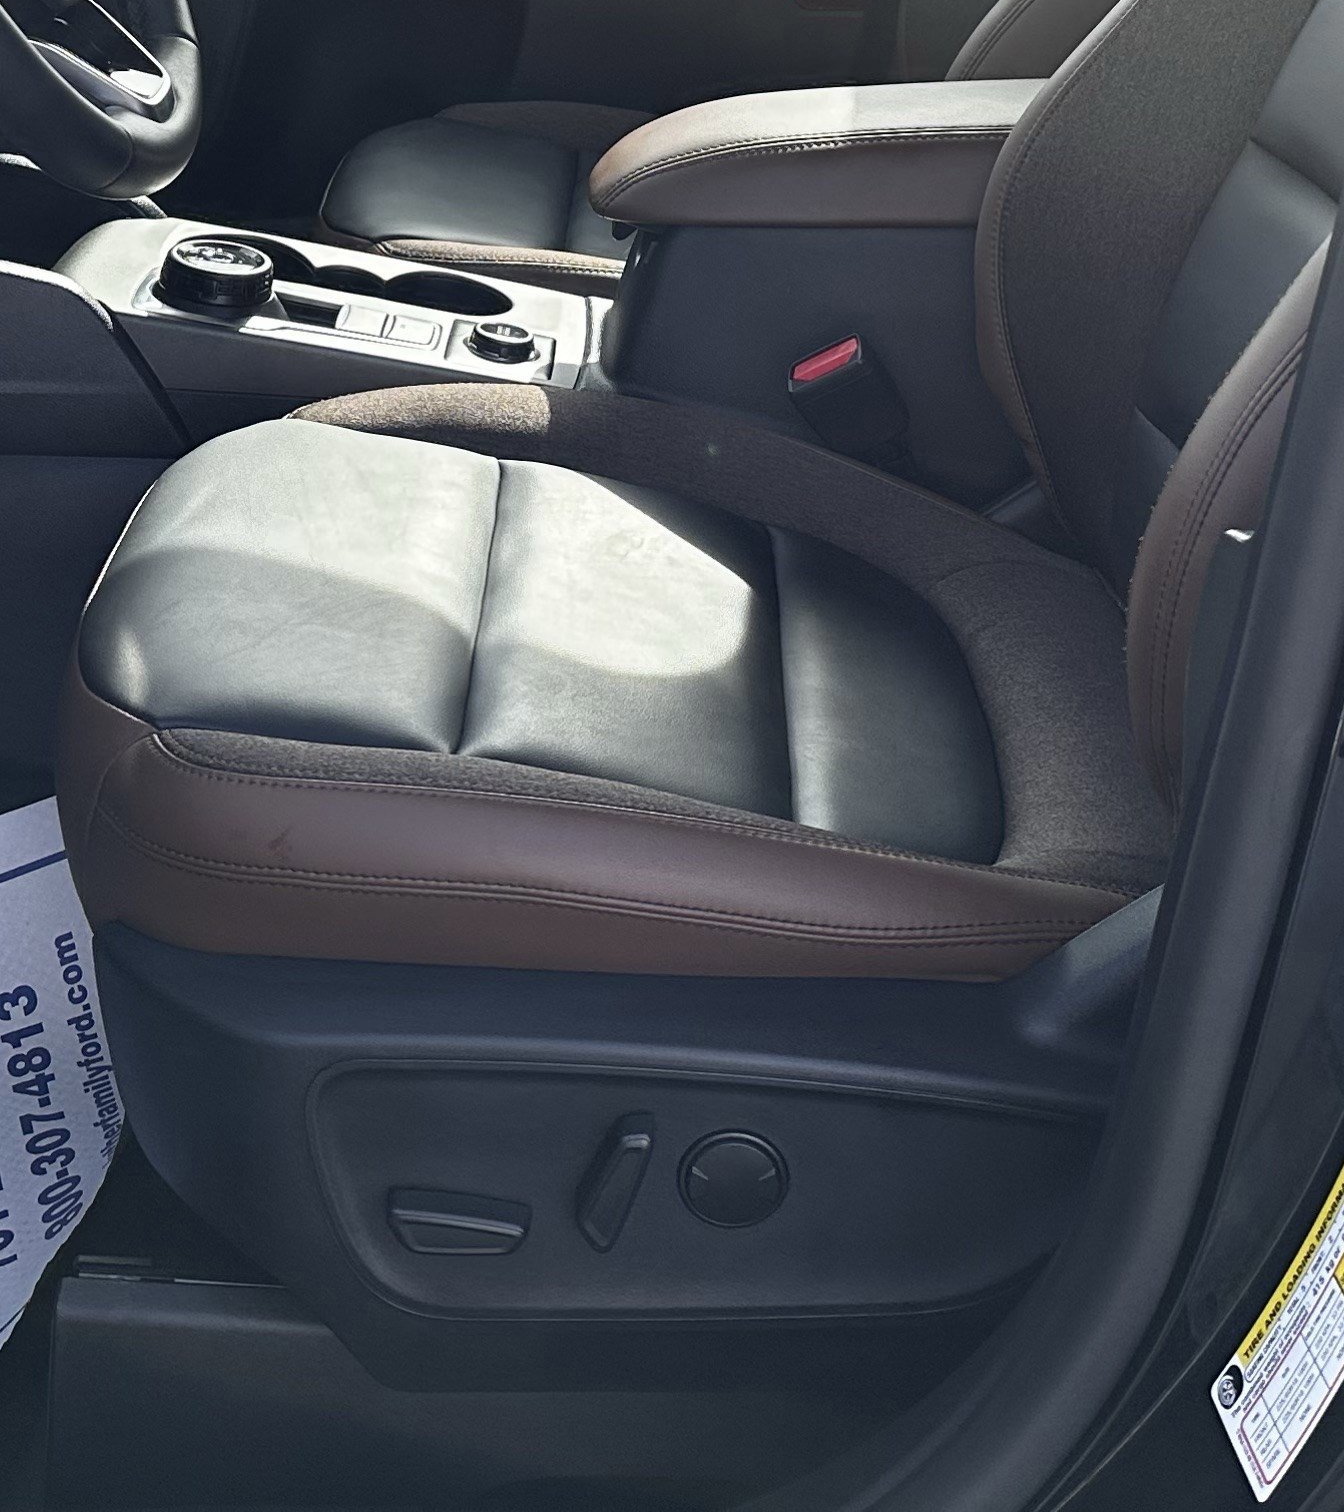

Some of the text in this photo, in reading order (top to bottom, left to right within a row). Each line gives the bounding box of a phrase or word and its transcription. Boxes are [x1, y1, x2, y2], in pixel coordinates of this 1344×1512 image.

[54, 930, 122, 1167] therfamilyford.com
[1243, 1327, 1264, 1361] TIRE
[1263, 1298, 1282, 1331] AND
[1281, 1240, 1316, 1301] LOADING
